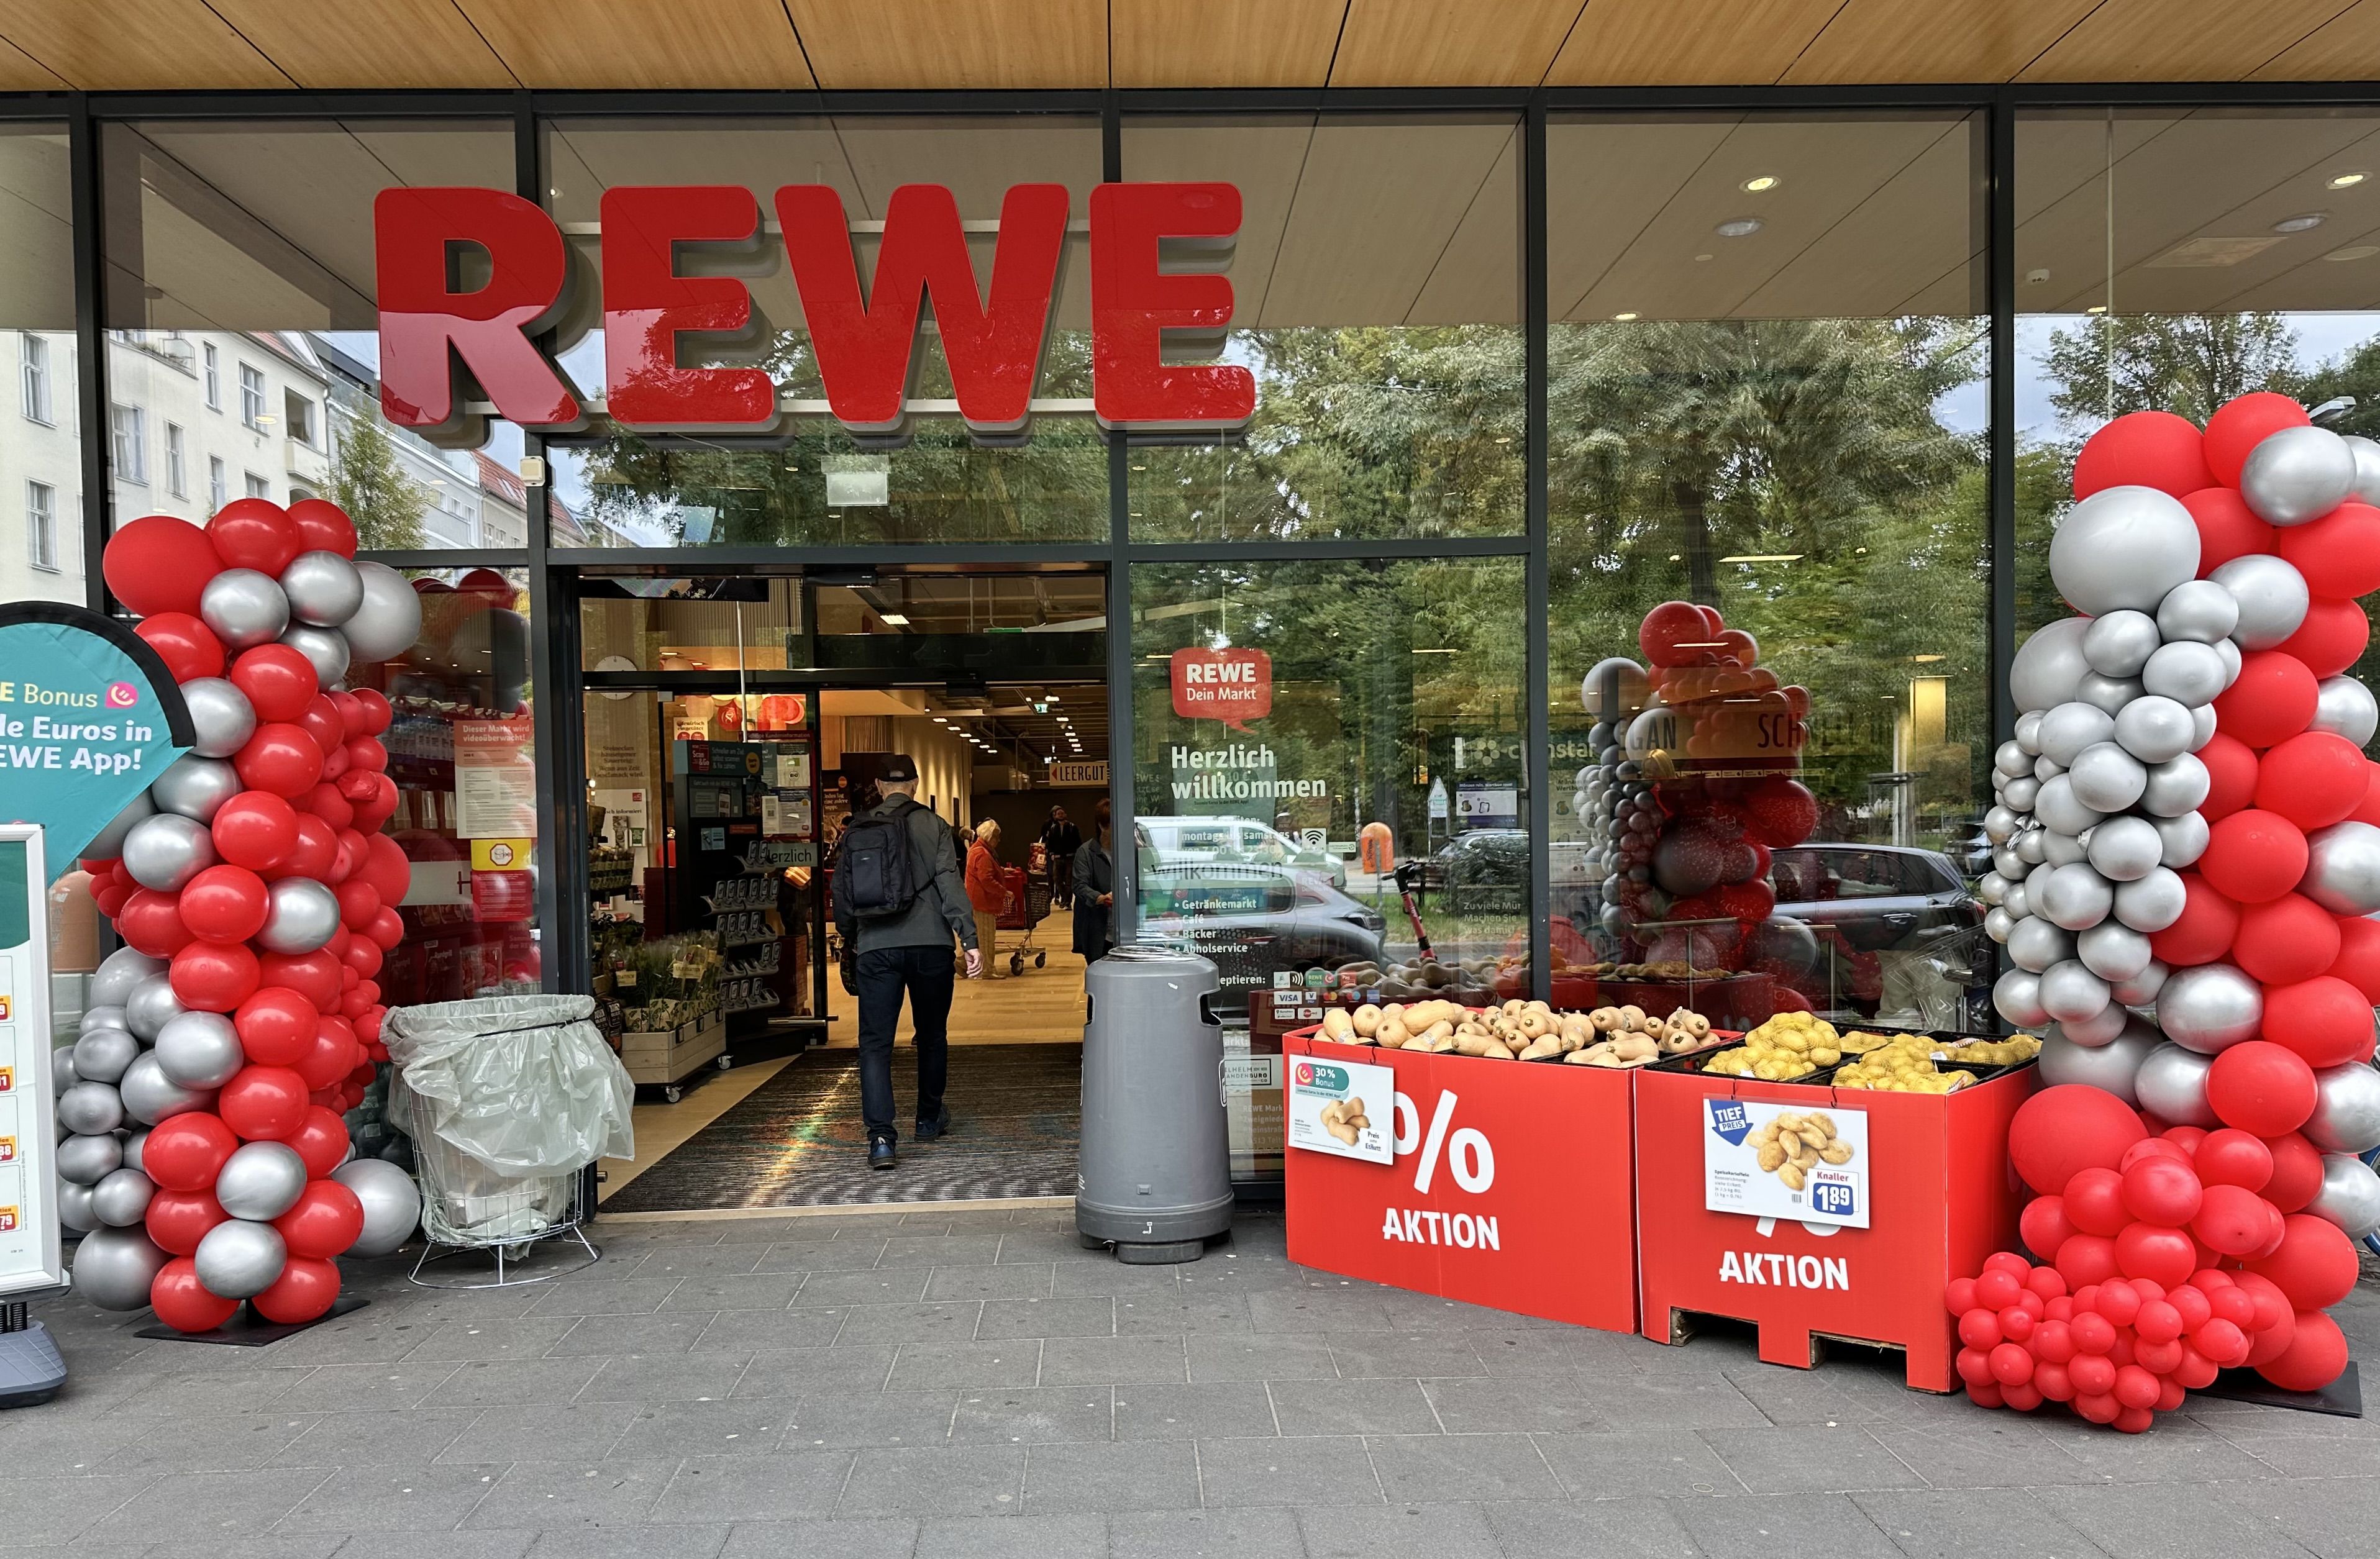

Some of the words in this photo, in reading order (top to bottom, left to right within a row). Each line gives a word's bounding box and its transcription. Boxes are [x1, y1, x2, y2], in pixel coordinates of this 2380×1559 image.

[374, 181, 1256, 427] REWE
[1187, 663, 1256, 683] REWE
[24, 683, 98, 707] Bonus
[1186, 687, 1214, 701] Dein
[1218, 686, 1257, 701] Markt
[32, 716, 117, 741] Euros
[125, 720, 152, 741] in
[1172, 743, 1274, 768] Herzlich
[1508, 740, 1597, 759] cnstar
[70, 747, 142, 775] App!
[1060, 765, 1105, 781] LEERGUT
[1172, 775, 1326, 799] willkommen
[1182, 832, 1224, 842] montags
[1182, 899, 1257, 910] Getränkemarkt
[1477, 901, 1500, 910] viele
[1182, 914, 1204, 924] Café
[1464, 914, 1502, 923] Machen
[1503, 914, 1517, 922] Sie
[1182, 928, 1216, 939] Bäcker
[1183, 943, 1247, 953] Abholservice
[1316, 1067, 1326, 1077] 30
[1327, 1069, 1336, 1078] %
[1315, 1078, 1334, 1088] Bonus
[1715, 1106, 1742, 1122] TIEF
[1722, 1121, 1744, 1130] PREIS
[1367, 1131, 1380, 1139] Preis
[1365, 1143, 1381, 1152] Etikett
[1817, 1171, 1849, 1182] Knaller
[1382, 1207, 1500, 1251] AKTION
[1718, 1250, 1849, 1291] AKTION
